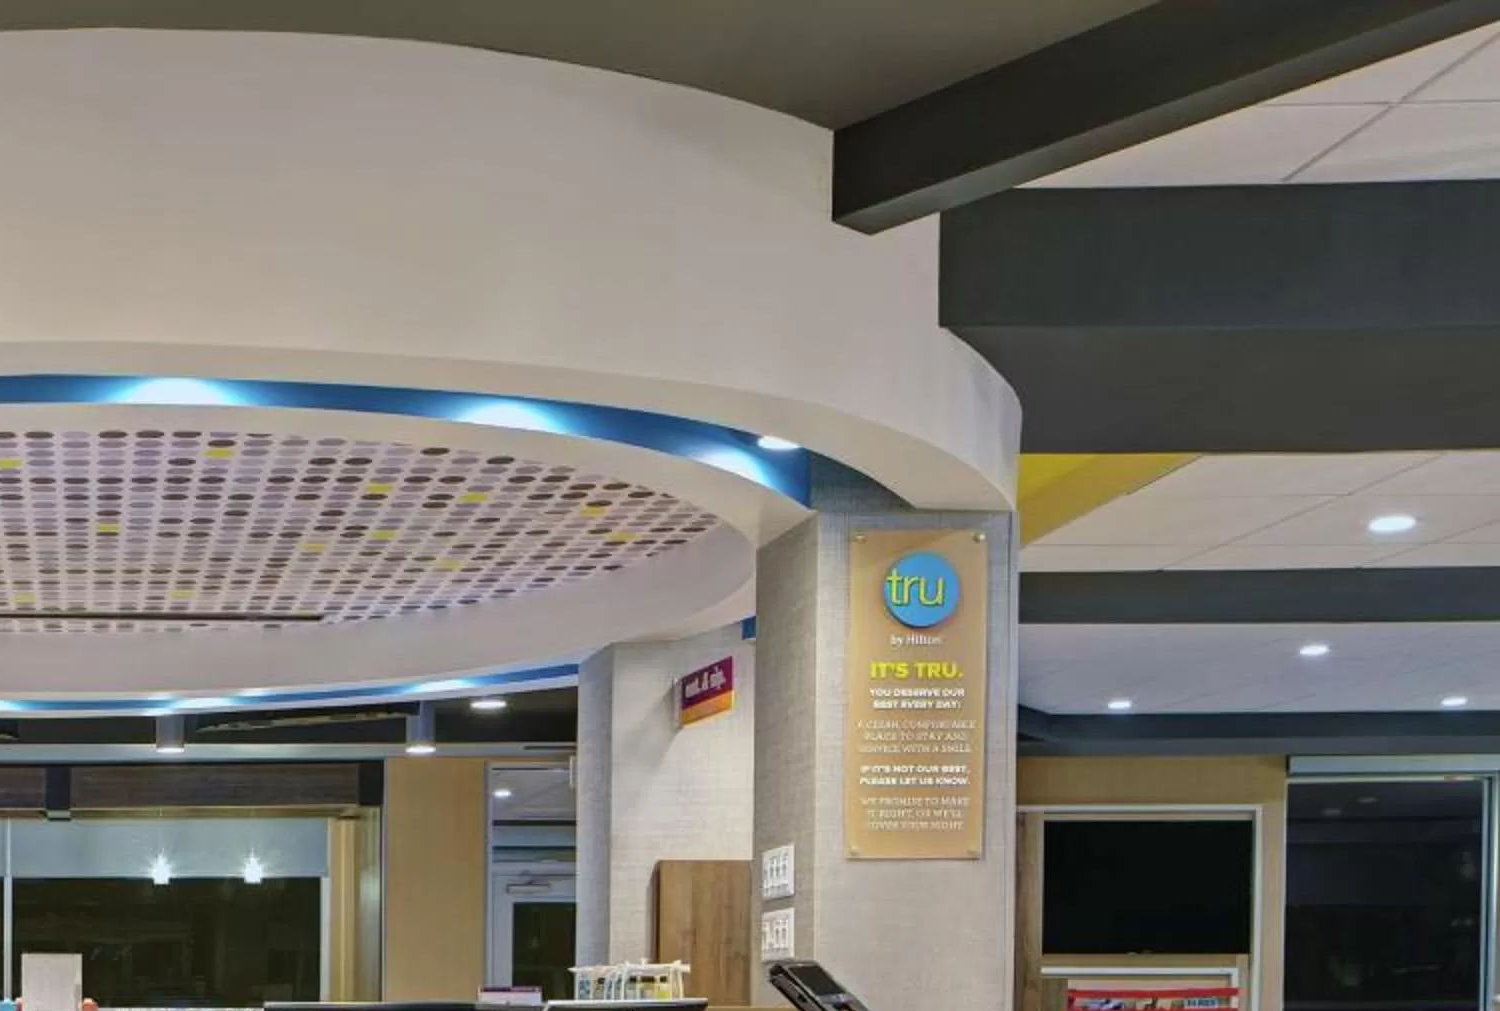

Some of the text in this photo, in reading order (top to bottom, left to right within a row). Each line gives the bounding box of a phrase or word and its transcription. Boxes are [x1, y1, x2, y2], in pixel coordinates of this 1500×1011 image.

[886, 567, 944, 607] tru
[869, 661, 964, 680] IT'S TRU.
[869, 687, 965, 697] YOU DESERVE OUR
[900, 699, 934, 709] EVERY
[893, 765, 915, 774] NOT
[917, 765, 939, 774] OUR
[899, 777, 917, 786] LET
